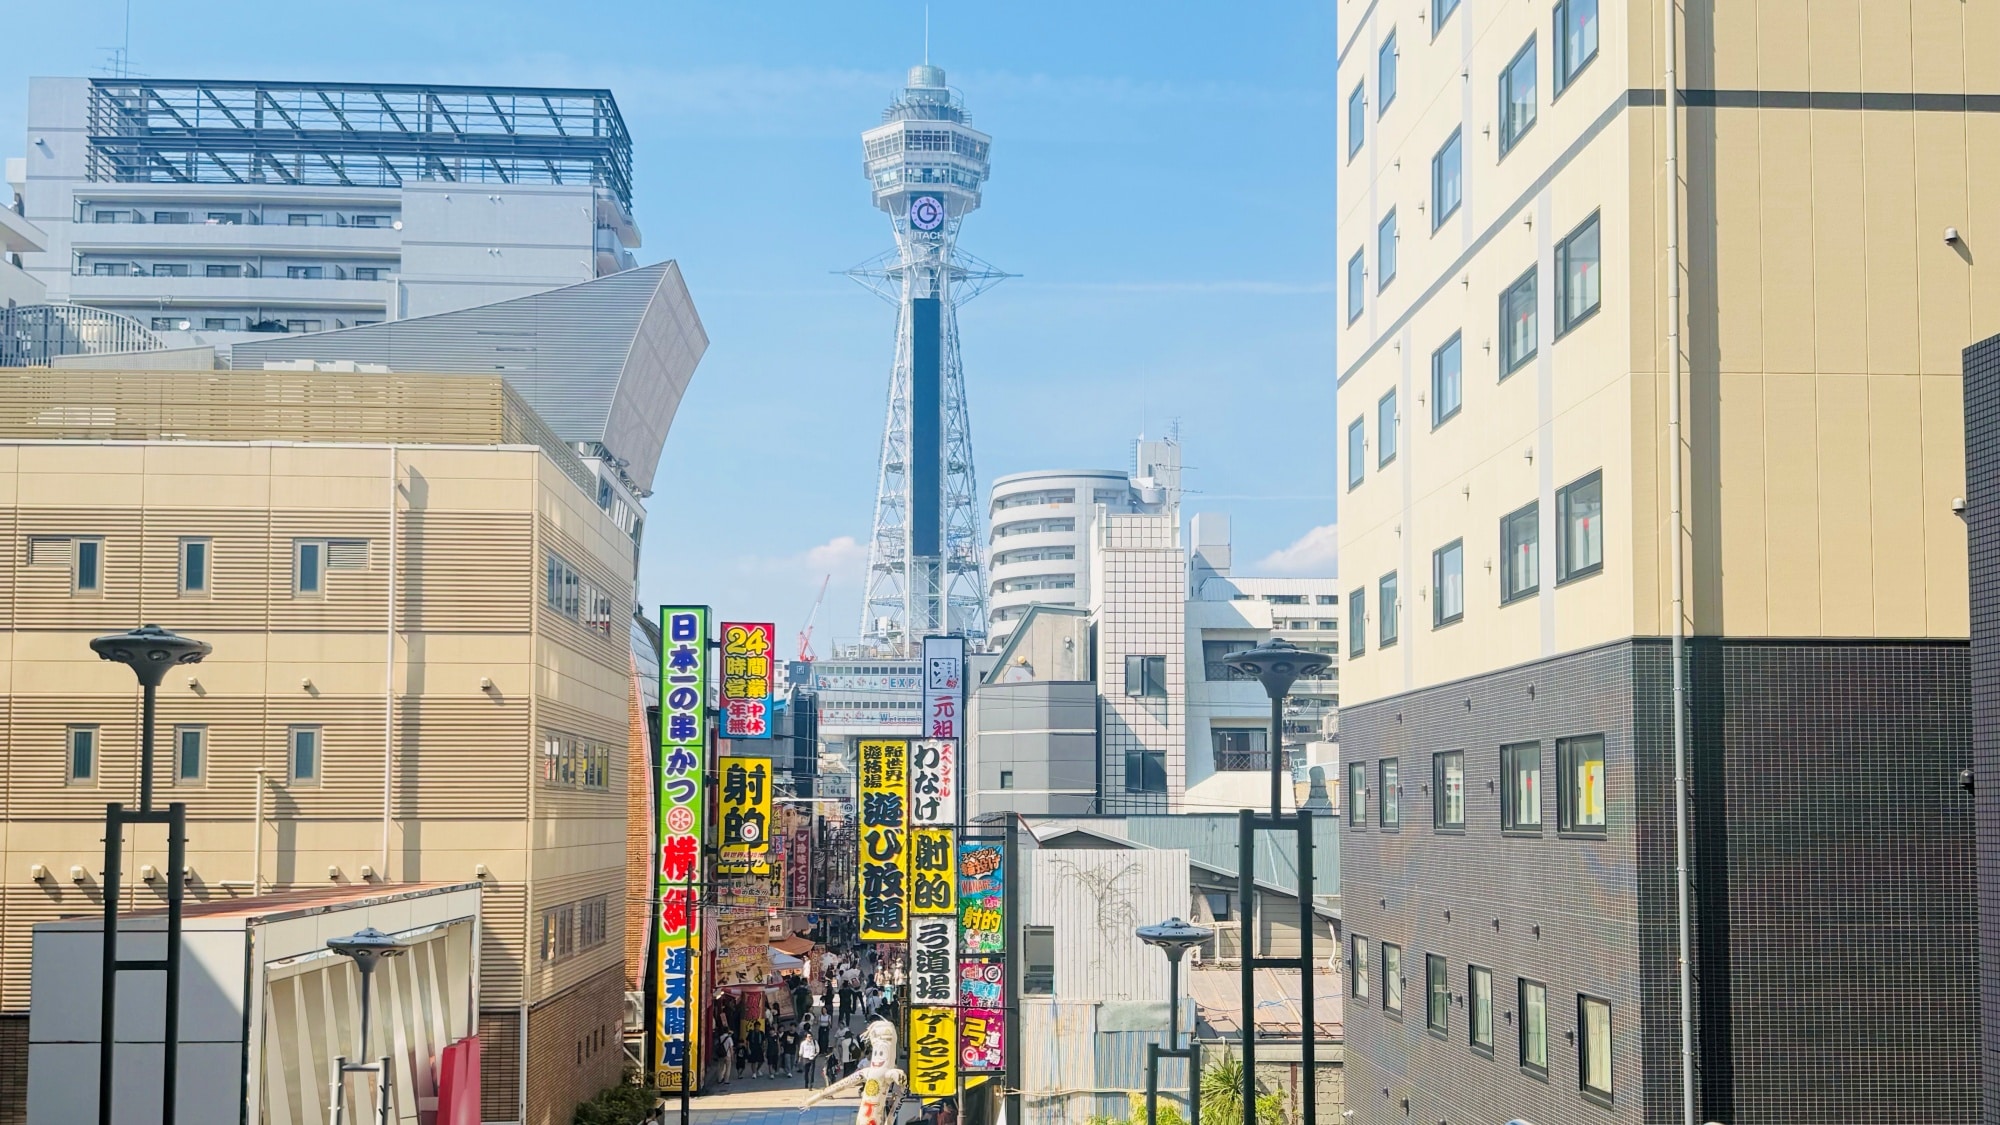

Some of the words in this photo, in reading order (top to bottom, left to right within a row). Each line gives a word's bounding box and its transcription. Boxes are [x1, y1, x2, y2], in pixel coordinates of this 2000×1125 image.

[726, 628, 769, 655] 24
[726, 656, 767, 676] 時間
[666, 614, 699, 803] 日本一の串かつ
[725, 677, 768, 699] 営業
[728, 702, 765, 718] 年中
[728, 718, 765, 735] 無休
[723, 764, 767, 848] 射的
[914, 745, 940, 821] わなげ
[939, 744, 953, 797] スペシャル
[662, 836, 698, 934] 横綱
[862, 791, 905, 933] 遊び放題
[915, 834, 950, 909] 射的
[962, 906, 1001, 933] 射的
[916, 923, 951, 1000] 弓道場
[663, 946, 692, 1067] 通天閣店
[916, 1013, 950, 1091] ゲームセンター
